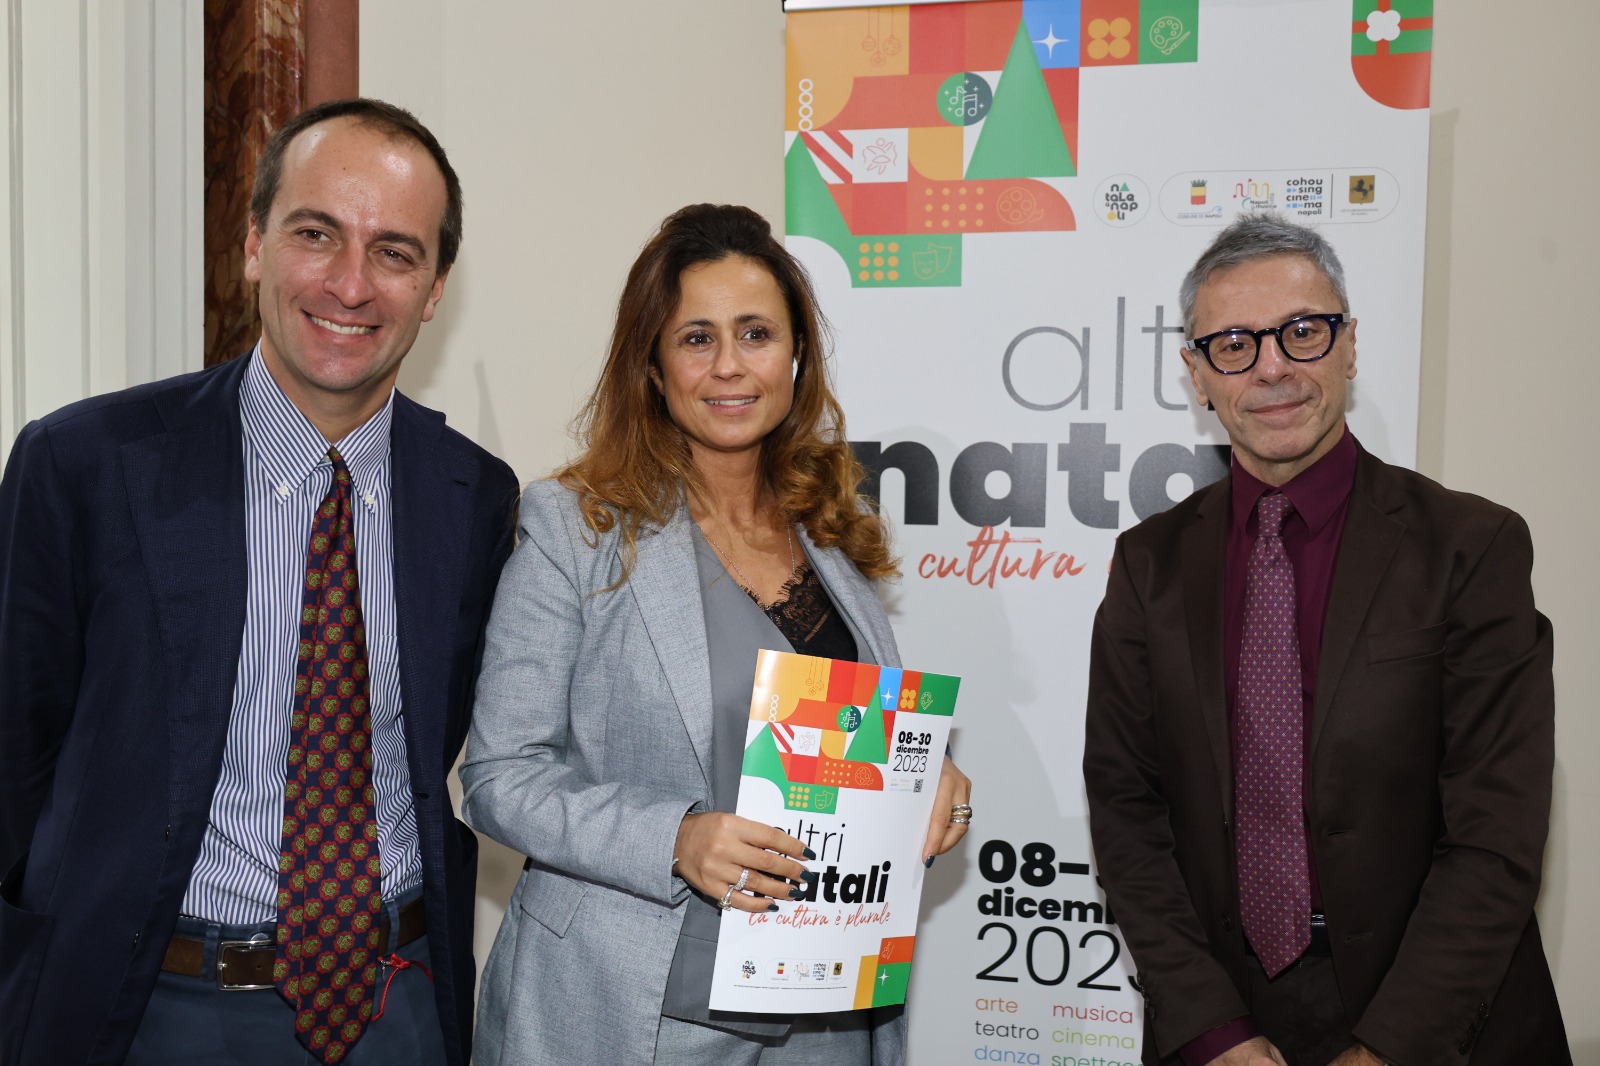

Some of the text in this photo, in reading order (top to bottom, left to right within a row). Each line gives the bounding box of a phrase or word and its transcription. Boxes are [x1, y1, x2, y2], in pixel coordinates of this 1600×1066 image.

[1286, 177, 1323, 186] cohou
[1002, 297, 1216, 411] alt
[918, 524, 1088, 590] cultura
[898, 731, 932, 746] 08-30
[896, 745, 929, 755] dicembre
[893, 754, 928, 773] 2023
[978, 839, 1105, 889] 08-
[776, 904, 829, 929] cultura
[844, 902, 891, 933] plurale
[976, 922, 1147, 993] 202
[975, 997, 1018, 1013] arte
[1053, 1004, 1134, 1024] musica
[975, 1020, 1040, 1040] teatro
[1052, 1027, 1135, 1049] cinema
[975, 1045, 1040, 1066] danza
